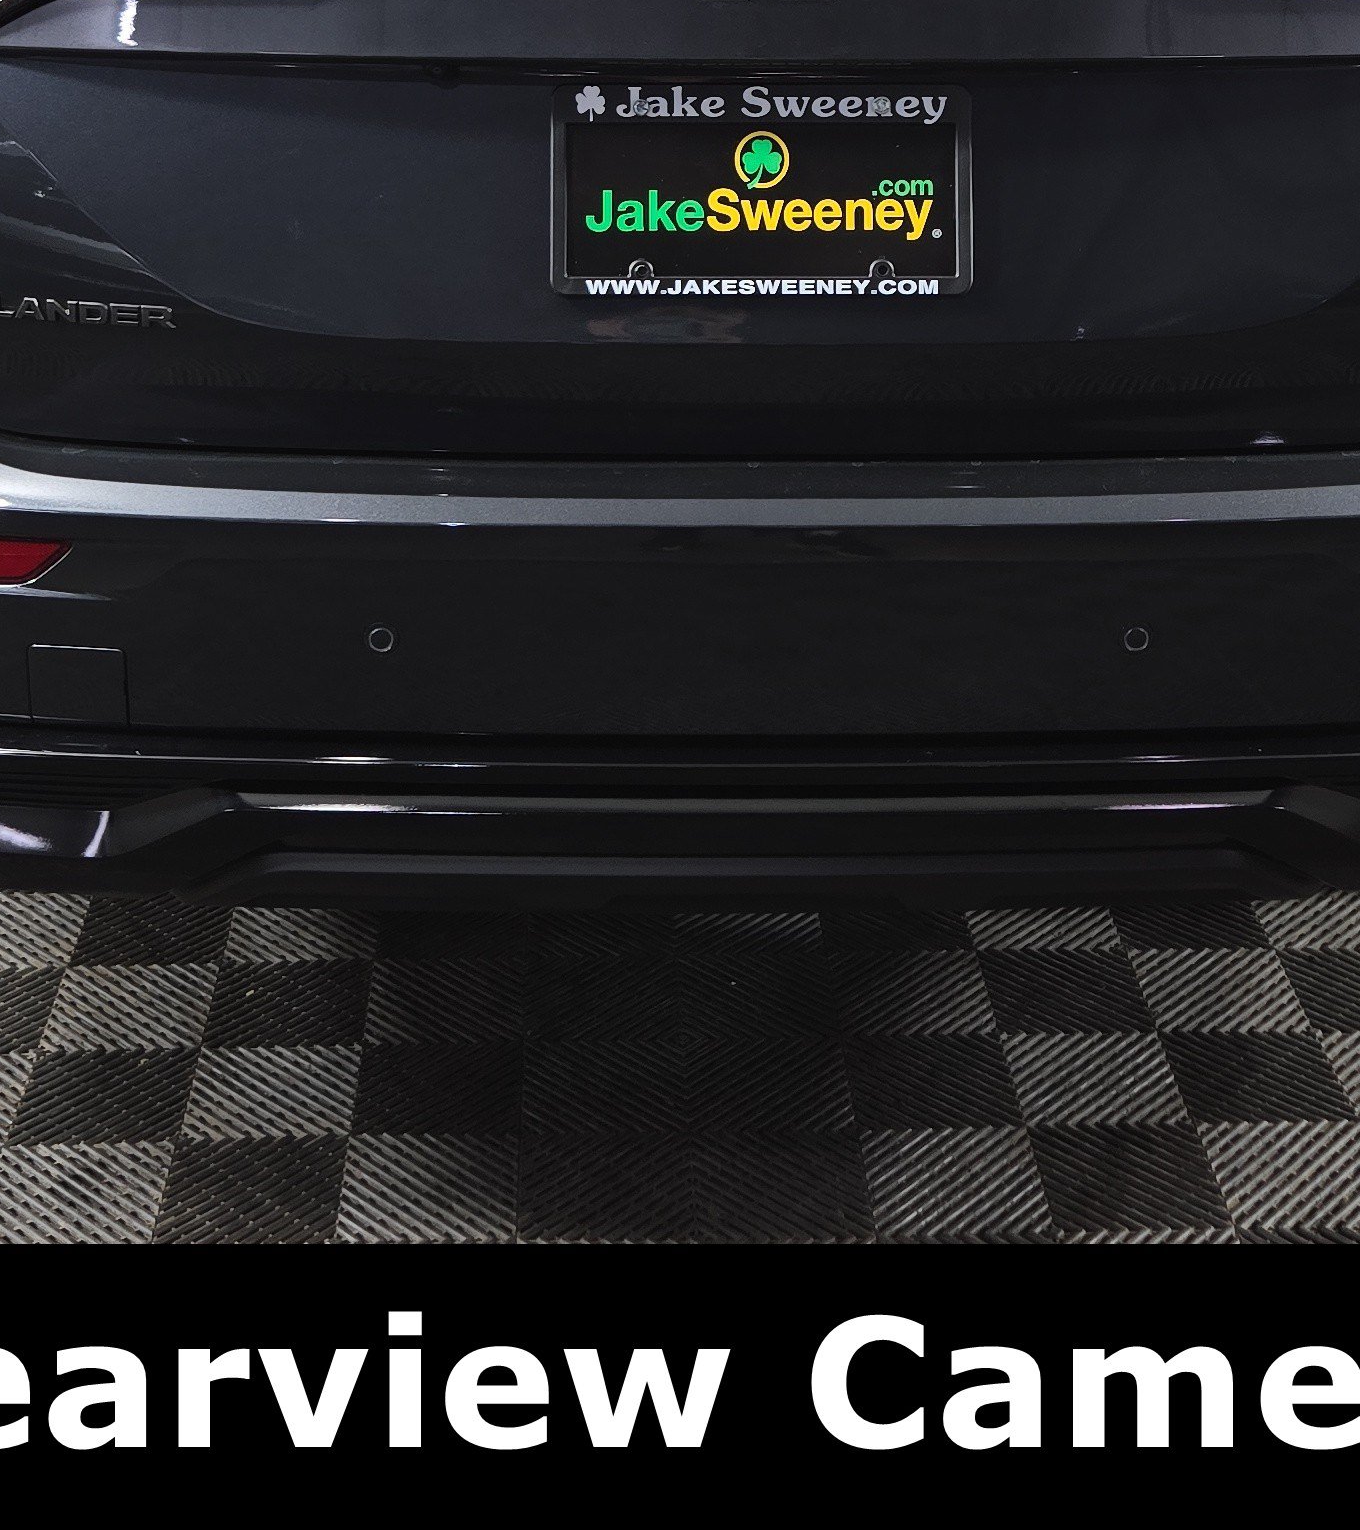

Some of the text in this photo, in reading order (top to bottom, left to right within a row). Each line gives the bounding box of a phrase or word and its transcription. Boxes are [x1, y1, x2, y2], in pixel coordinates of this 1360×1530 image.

[616, 86, 948, 125] Jake Sweeney
[585, 279, 940, 295] WWW.JAKESWEENEY.COM
